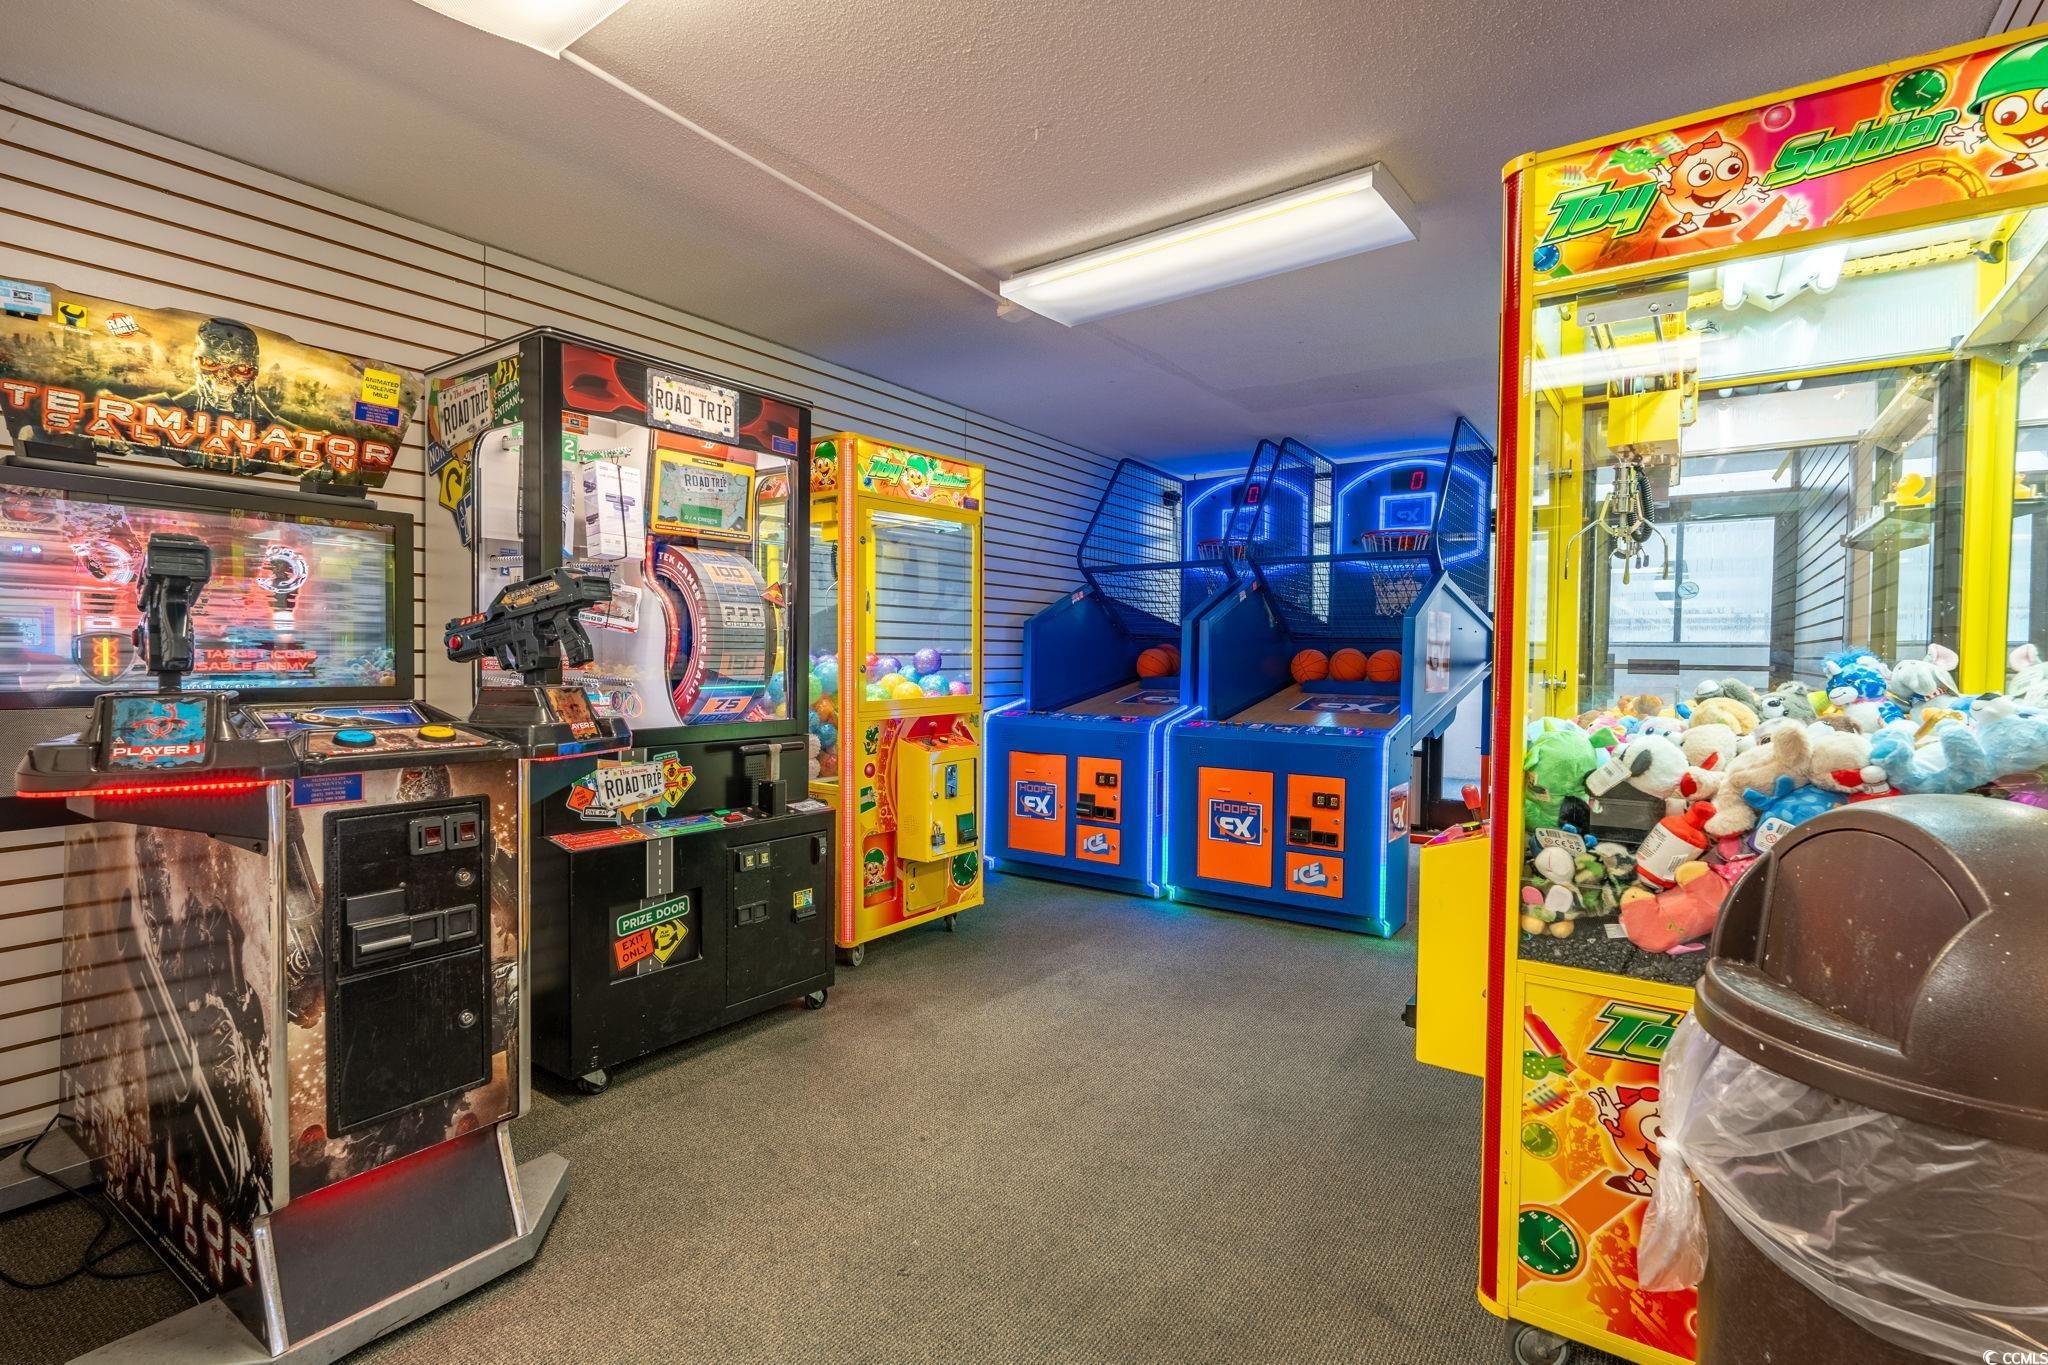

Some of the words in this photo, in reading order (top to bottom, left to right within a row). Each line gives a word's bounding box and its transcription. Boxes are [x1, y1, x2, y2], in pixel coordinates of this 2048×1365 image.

[1769, 107, 1961, 188] Soldier
[1542, 177, 1659, 243] Toy
[105, 314, 136, 331] RAW
[111, 324, 139, 336] THRILLS
[365, 376, 399, 388] ANIMATED
[365, 383, 397, 394] VIOLENCE
[443, 400, 470, 436] ROAD
[470, 390, 489, 419] TRIP
[655, 388, 692, 415] ROAD
[699, 399, 732, 424] TRIP
[3, 382, 391, 463] TERMINATOR
[47, 412, 353, 470] SALVATION
[564, 440, 575, 453] 2
[684, 473, 710, 488] ROAD
[712, 476, 727, 488] TRIP
[867, 455, 904, 487] Toy
[1410, 470, 1424, 491] 0
[1247, 485, 1259, 503] 0
[658, 551, 676, 565] TEK
[677, 562, 701, 600] GAMES
[712, 565, 744, 577] 100
[205, 649, 264, 659] TARGET
[255, 662, 308, 671] ENEMY
[685, 660, 705, 703] RALLY
[714, 698, 741, 710] 75
[113, 745, 185, 757] PLAYER
[193, 745, 201, 754] 1
[604, 776, 639, 800] ROAD
[640, 772, 662, 789] TRIP
[1019, 783, 1054, 795] HOOPS
[1024, 794, 1051, 814] FX
[1213, 802, 1258, 815] HOOPS
[1219, 816, 1254, 838] FX
[1083, 832, 1108, 853] ICE
[1293, 861, 1326, 883] ICE
[622, 911, 654, 931] PRIZE
[656, 901, 685, 919] DOOR
[622, 933, 644, 951] EXIT
[622, 943, 648, 963] ONLY
[1587, 1001, 1687, 1063] To
